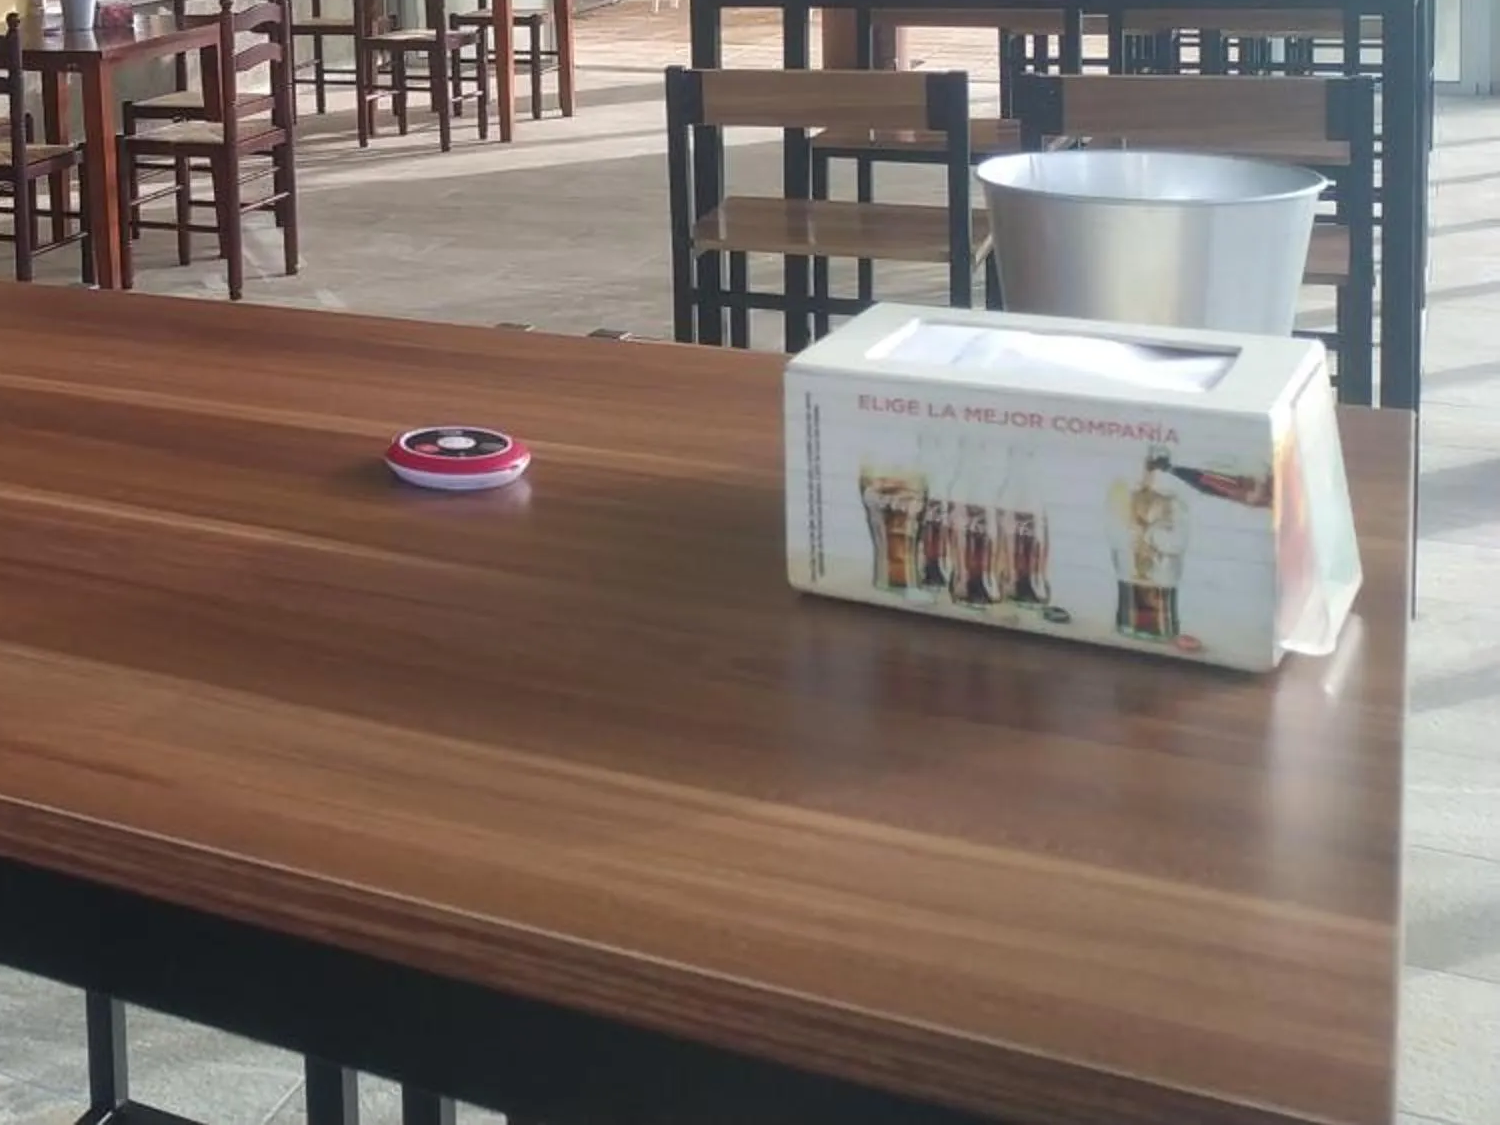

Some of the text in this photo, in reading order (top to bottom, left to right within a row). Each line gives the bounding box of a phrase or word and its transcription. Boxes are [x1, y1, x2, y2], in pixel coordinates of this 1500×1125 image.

[857, 393, 1181, 446] ELIGE LA MEJOR COMPAÑÍA
